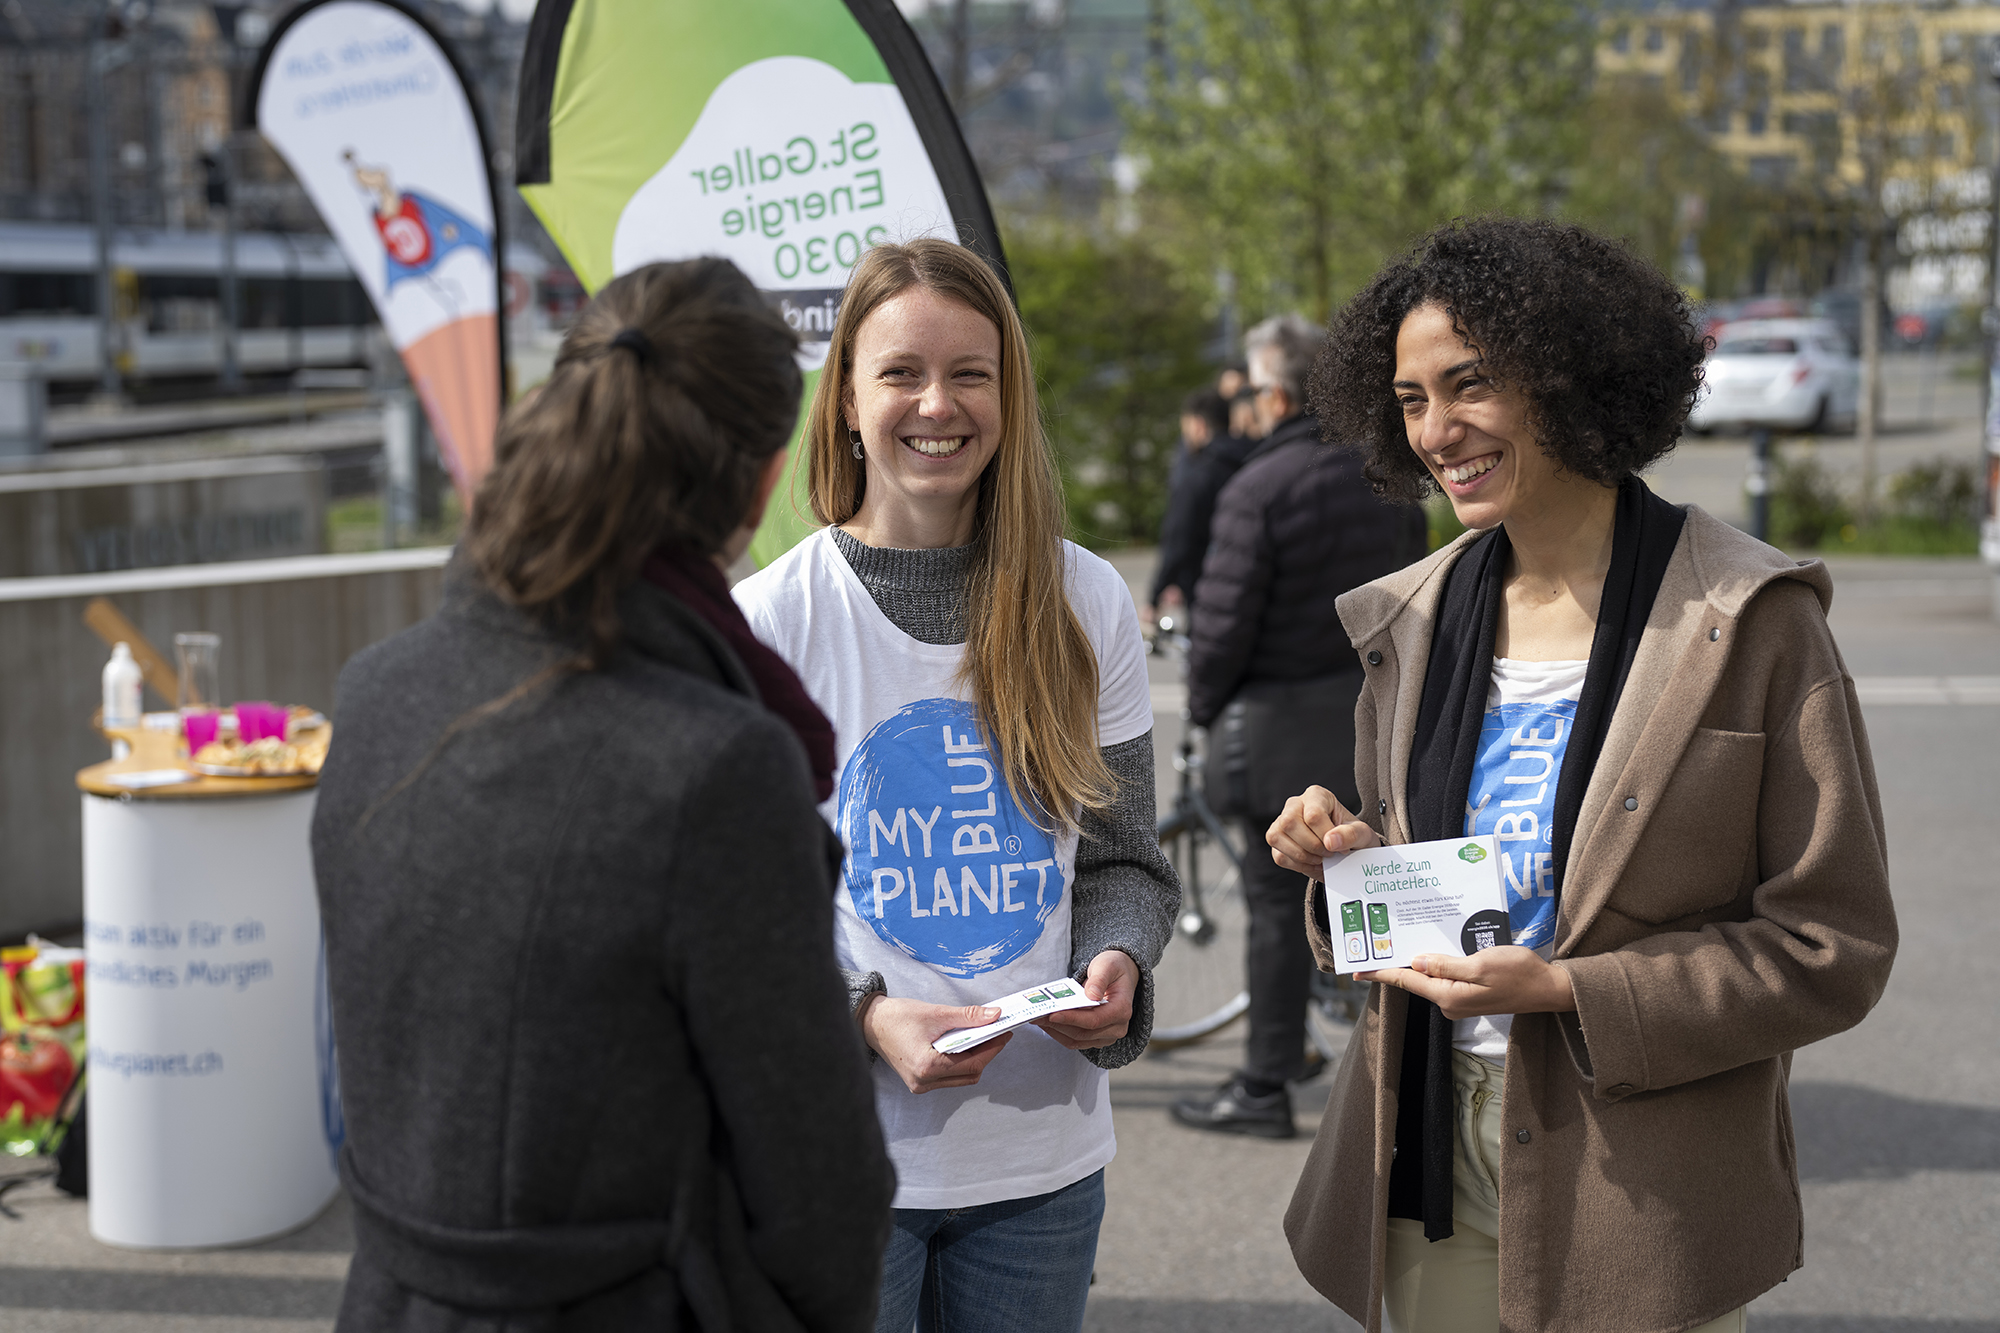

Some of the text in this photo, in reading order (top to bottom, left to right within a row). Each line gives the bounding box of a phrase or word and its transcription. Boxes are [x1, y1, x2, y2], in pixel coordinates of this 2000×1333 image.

[1493, 718, 1565, 842] BLUE
[868, 805, 942, 858] MY
[871, 857, 1054, 919] PLANET
[1361, 860, 1431, 877] Werde zum
[1364, 875, 1442, 895] ClimateHero.
